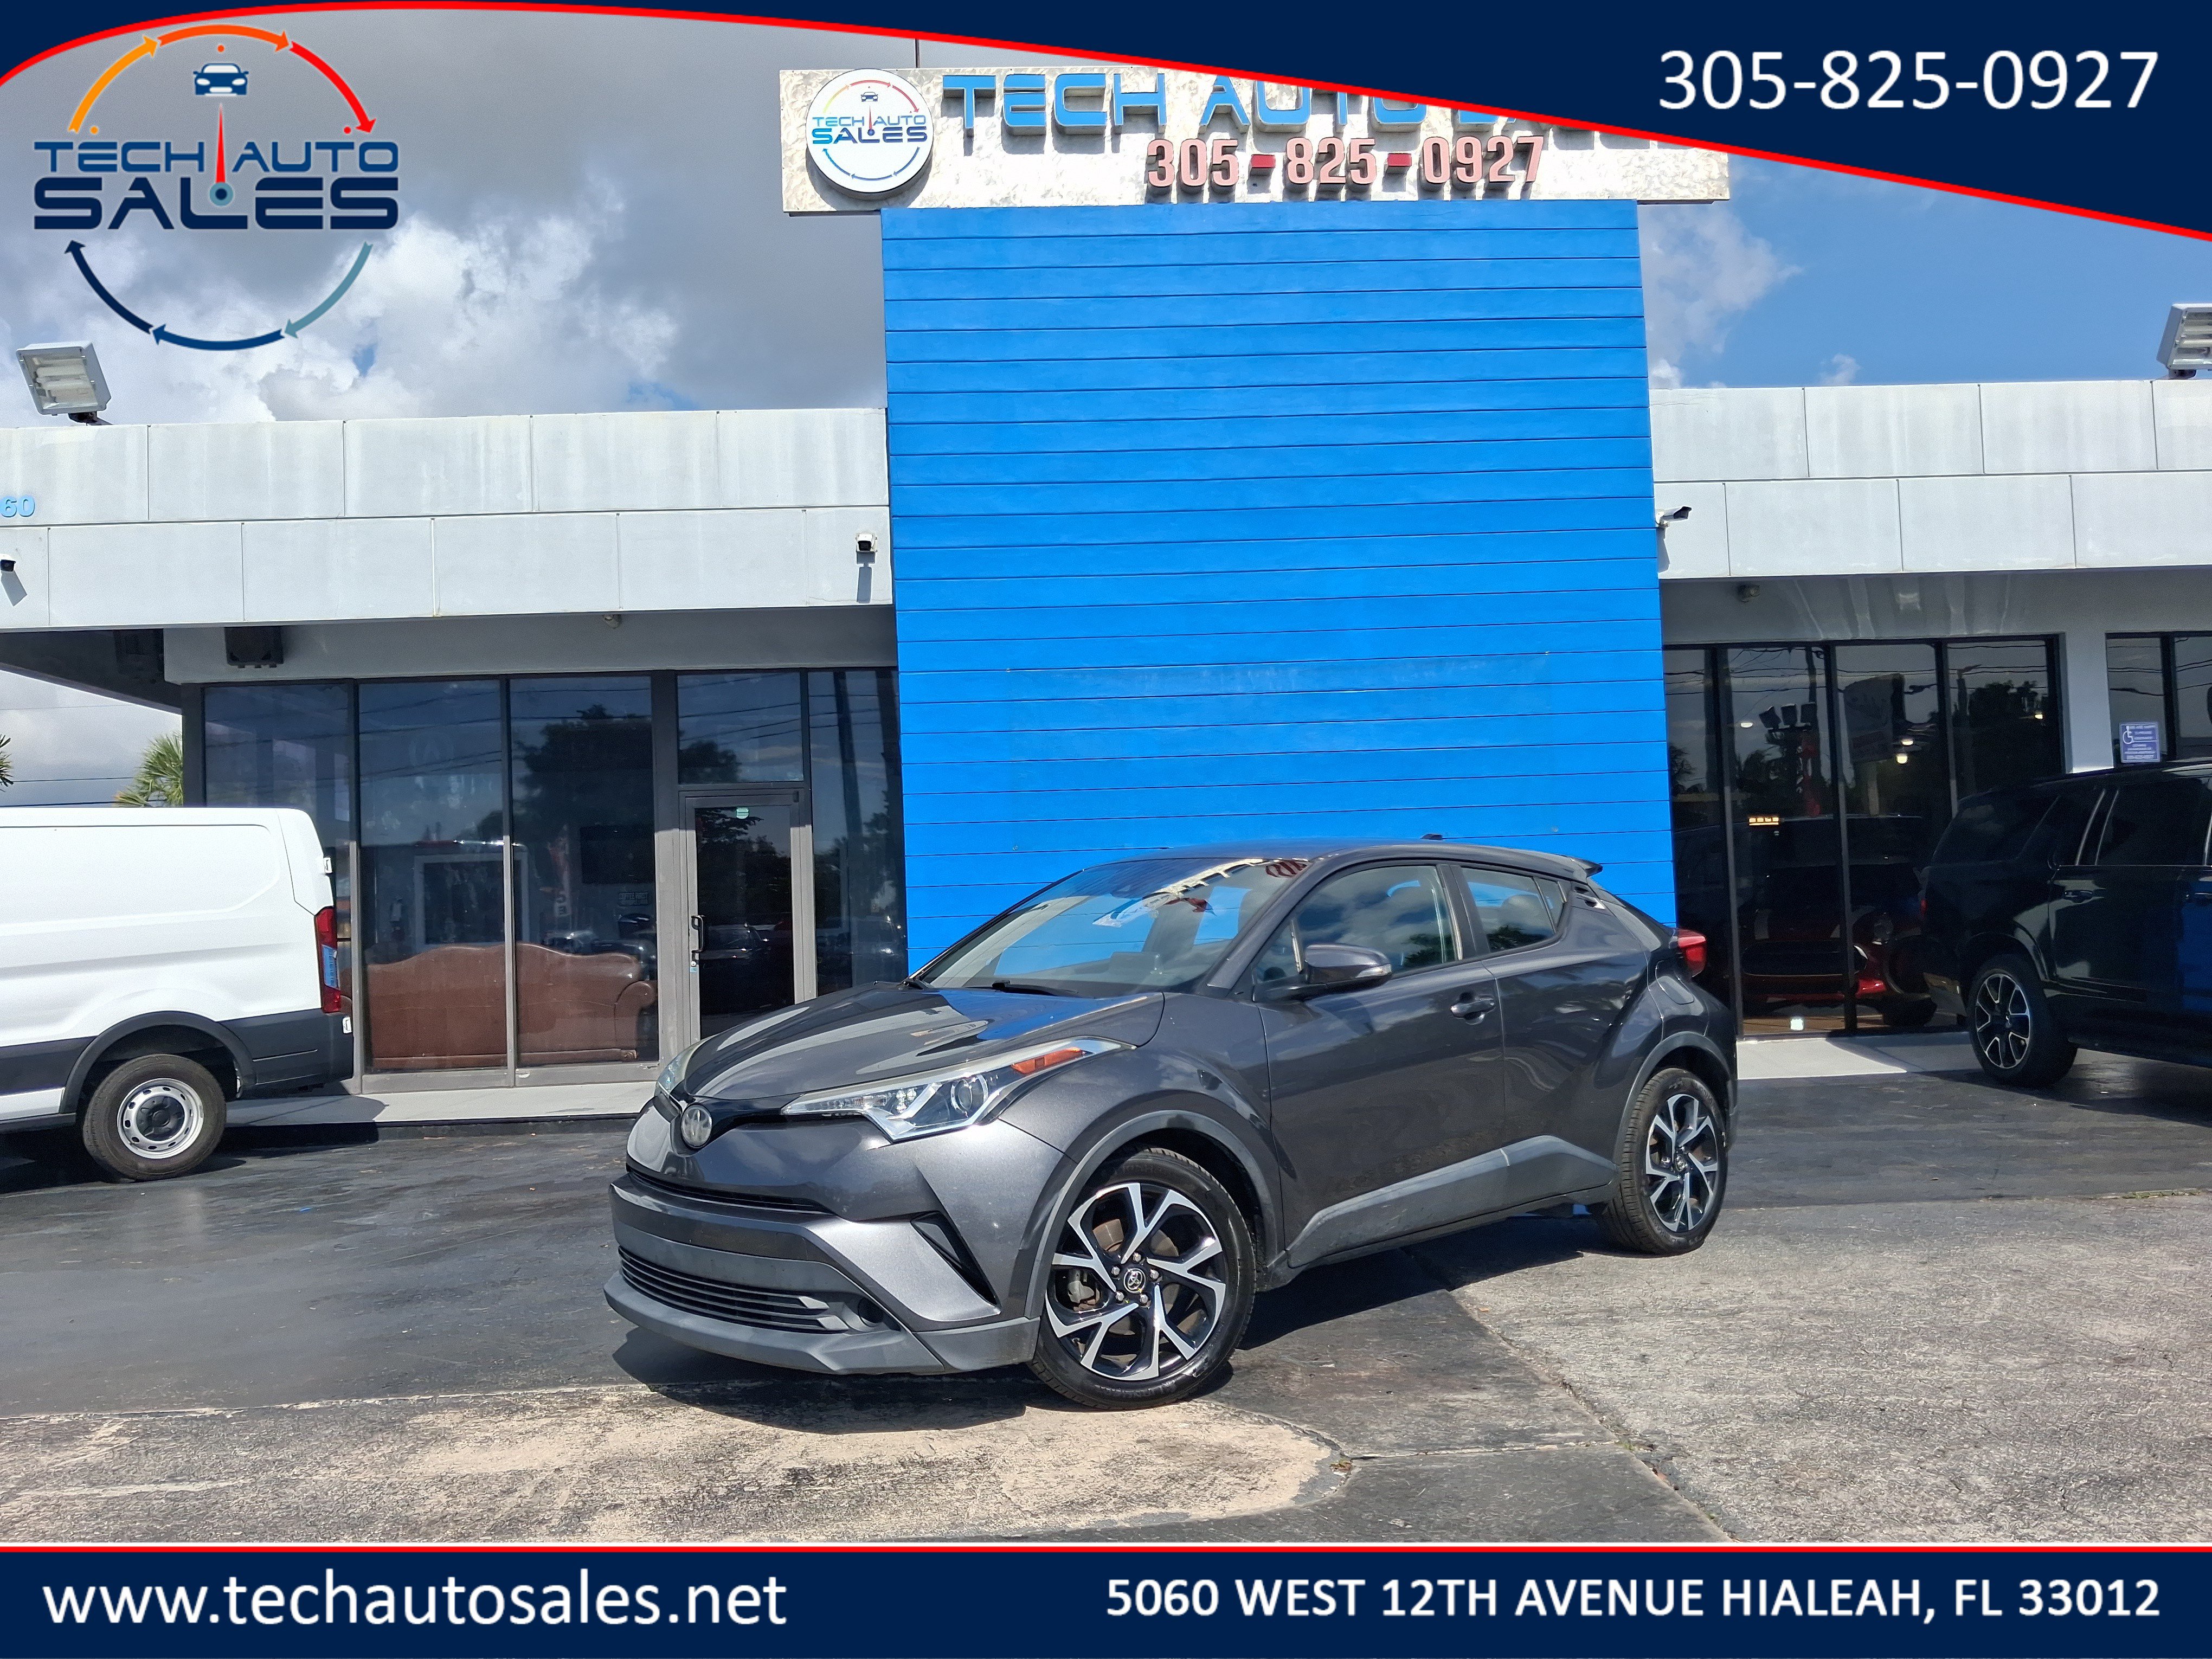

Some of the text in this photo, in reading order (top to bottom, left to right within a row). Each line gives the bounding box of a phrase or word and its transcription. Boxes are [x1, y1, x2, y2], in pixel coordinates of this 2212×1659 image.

[942, 73, 1166, 128] TECH
[812, 115, 927, 127] TECH AUTO
[812, 126, 928, 144] SALES
[1147, 136, 1544, 189] 305-825-0927
